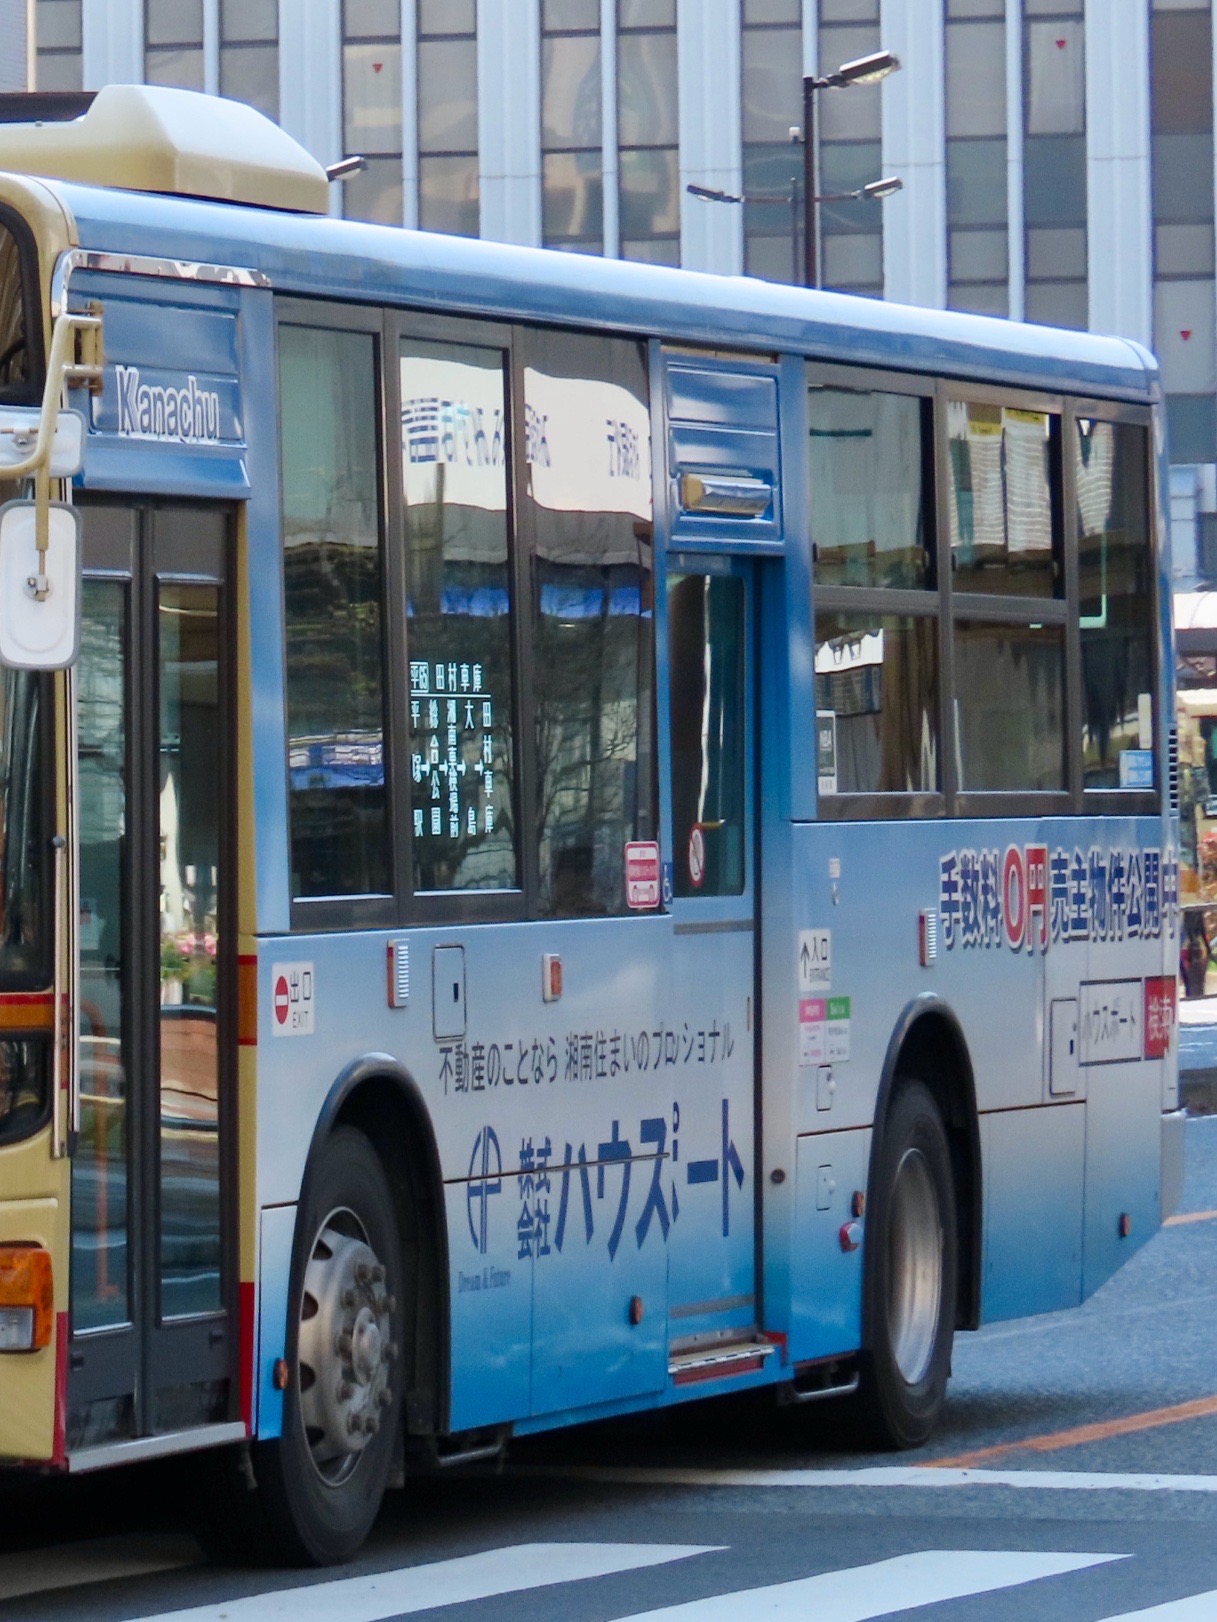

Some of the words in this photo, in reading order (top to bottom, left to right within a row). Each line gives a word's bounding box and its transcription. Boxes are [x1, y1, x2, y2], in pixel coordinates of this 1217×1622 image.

[115, 365, 220, 444] Kanachu
[290, 970, 311, 1002] 出口
[439, 1036, 558, 1096] 不動産のことなら
